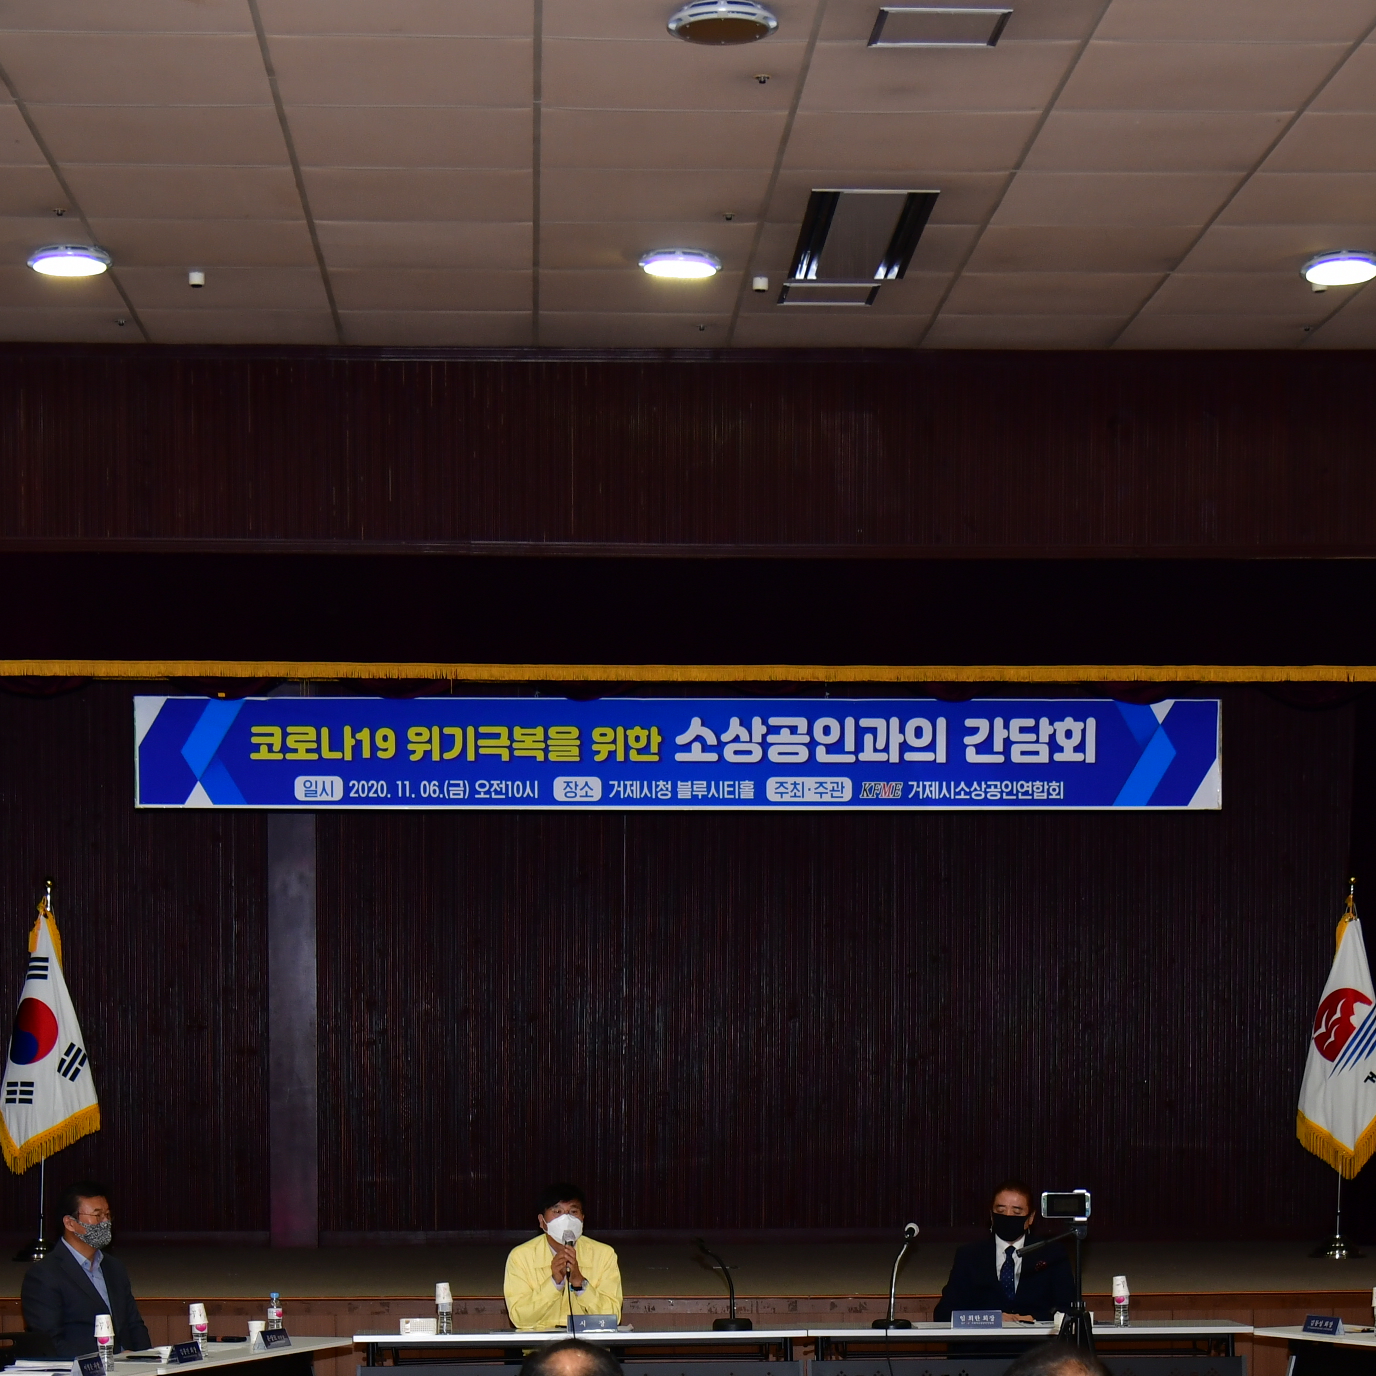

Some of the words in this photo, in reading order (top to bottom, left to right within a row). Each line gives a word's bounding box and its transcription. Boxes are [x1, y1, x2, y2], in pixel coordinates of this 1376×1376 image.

[249, 725, 396, 761] 코로나19
[407, 725, 581, 762] 위기극복을
[591, 725, 662, 762] 위한
[674, 716, 947, 763] 소상공인과의
[963, 716, 1096, 763] 간담회
[302, 779, 334, 798] 일시
[349, 780, 392, 799] 2020.
[396, 780, 415, 799] 11.
[420, 780, 469, 799] 06.(금)
[474, 780, 539, 799] 오전10시
[562, 779, 594, 798] 장소
[608, 779, 671, 799] 거제시청
[677, 780, 754, 799] 블루시티홀
[773, 780, 845, 799] 주최·주관
[860, 781, 903, 799] KFME
[908, 780, 1064, 799] 거제시소상공인연합회
